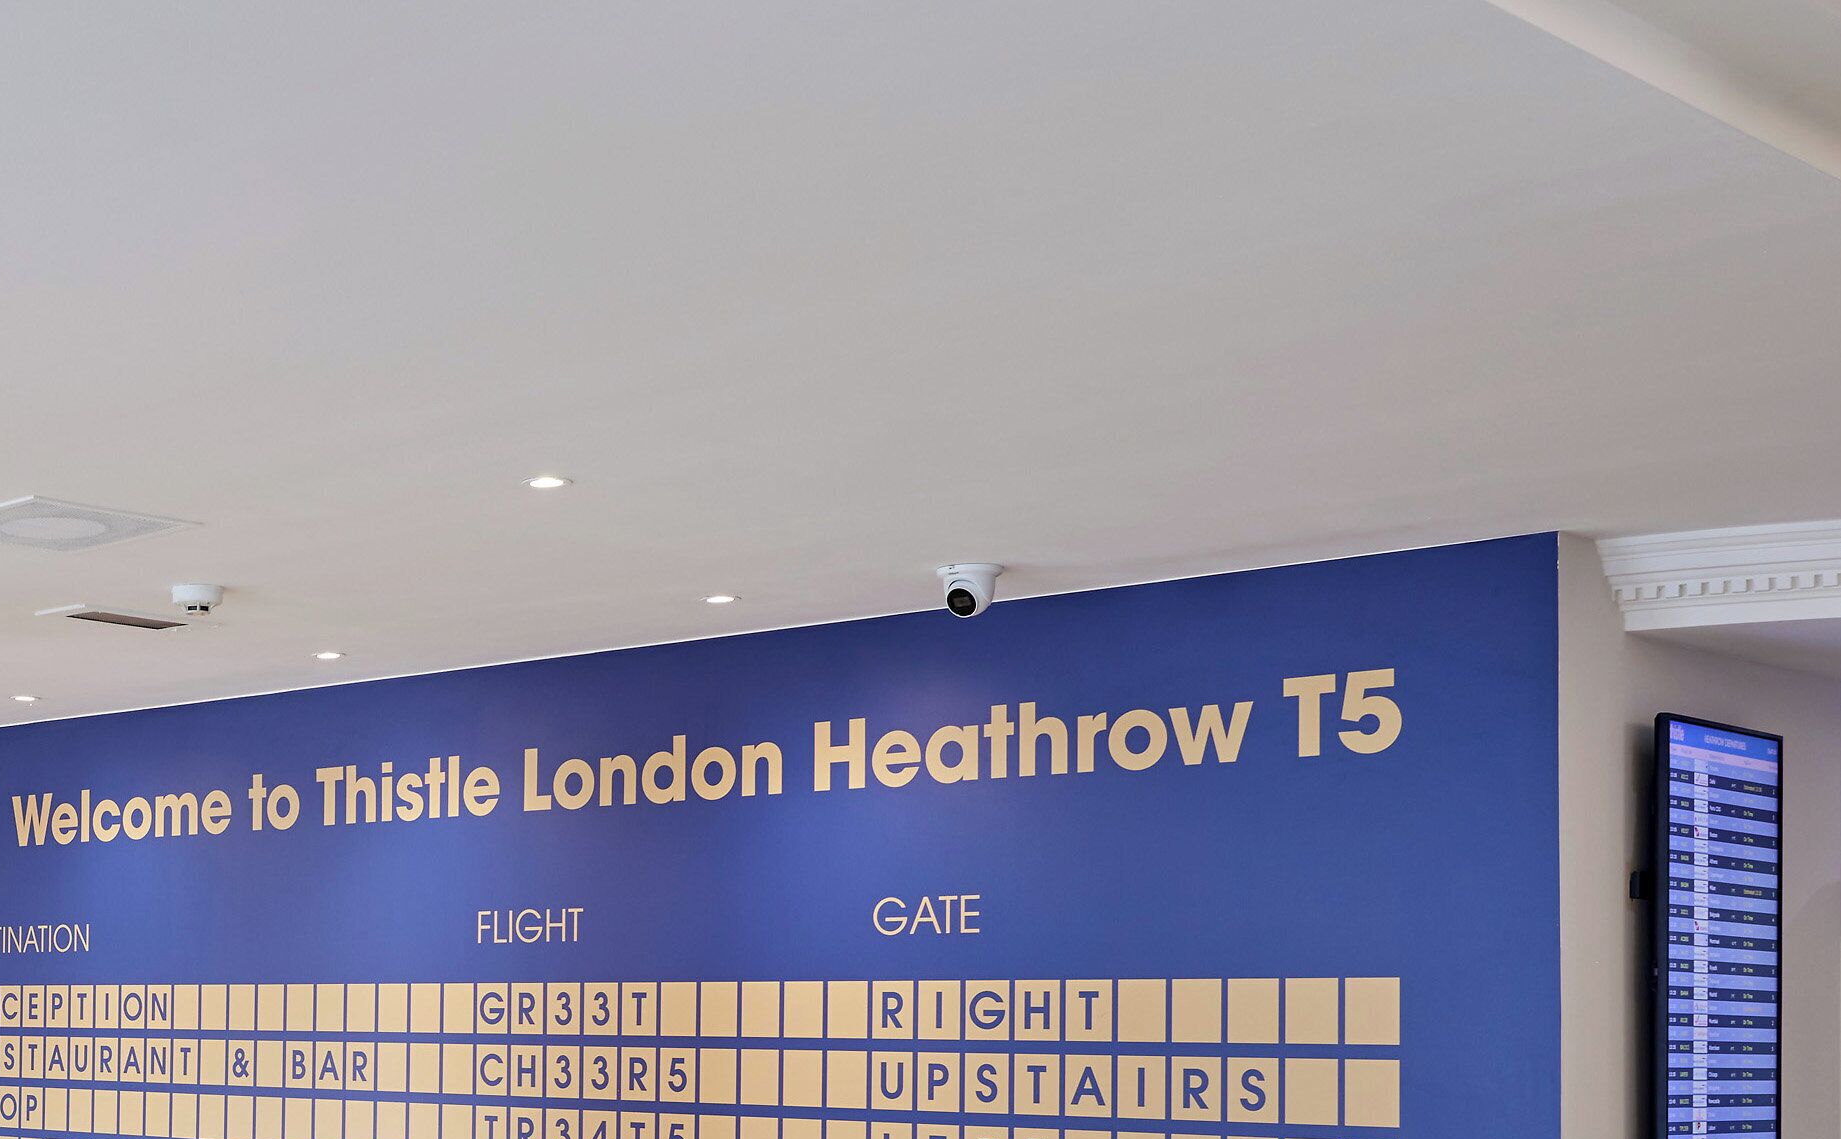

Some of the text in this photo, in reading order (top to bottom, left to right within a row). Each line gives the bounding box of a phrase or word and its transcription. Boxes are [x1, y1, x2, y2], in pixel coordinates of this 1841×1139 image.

[12, 668, 1402, 847] Welcome to Thistle London Heathrow T5
[478, 908, 585, 944] FLIGHT
[873, 895, 979, 935] GATE
[480, 992, 646, 1024] GR33T
[881, 990, 1099, 1031] RIGHT
[232, 1048, 249, 1080] &
[292, 1050, 366, 1080] BAR
[480, 1054, 686, 1091] CH33R5
[882, 1063, 1265, 1110] UPSTAIRS
